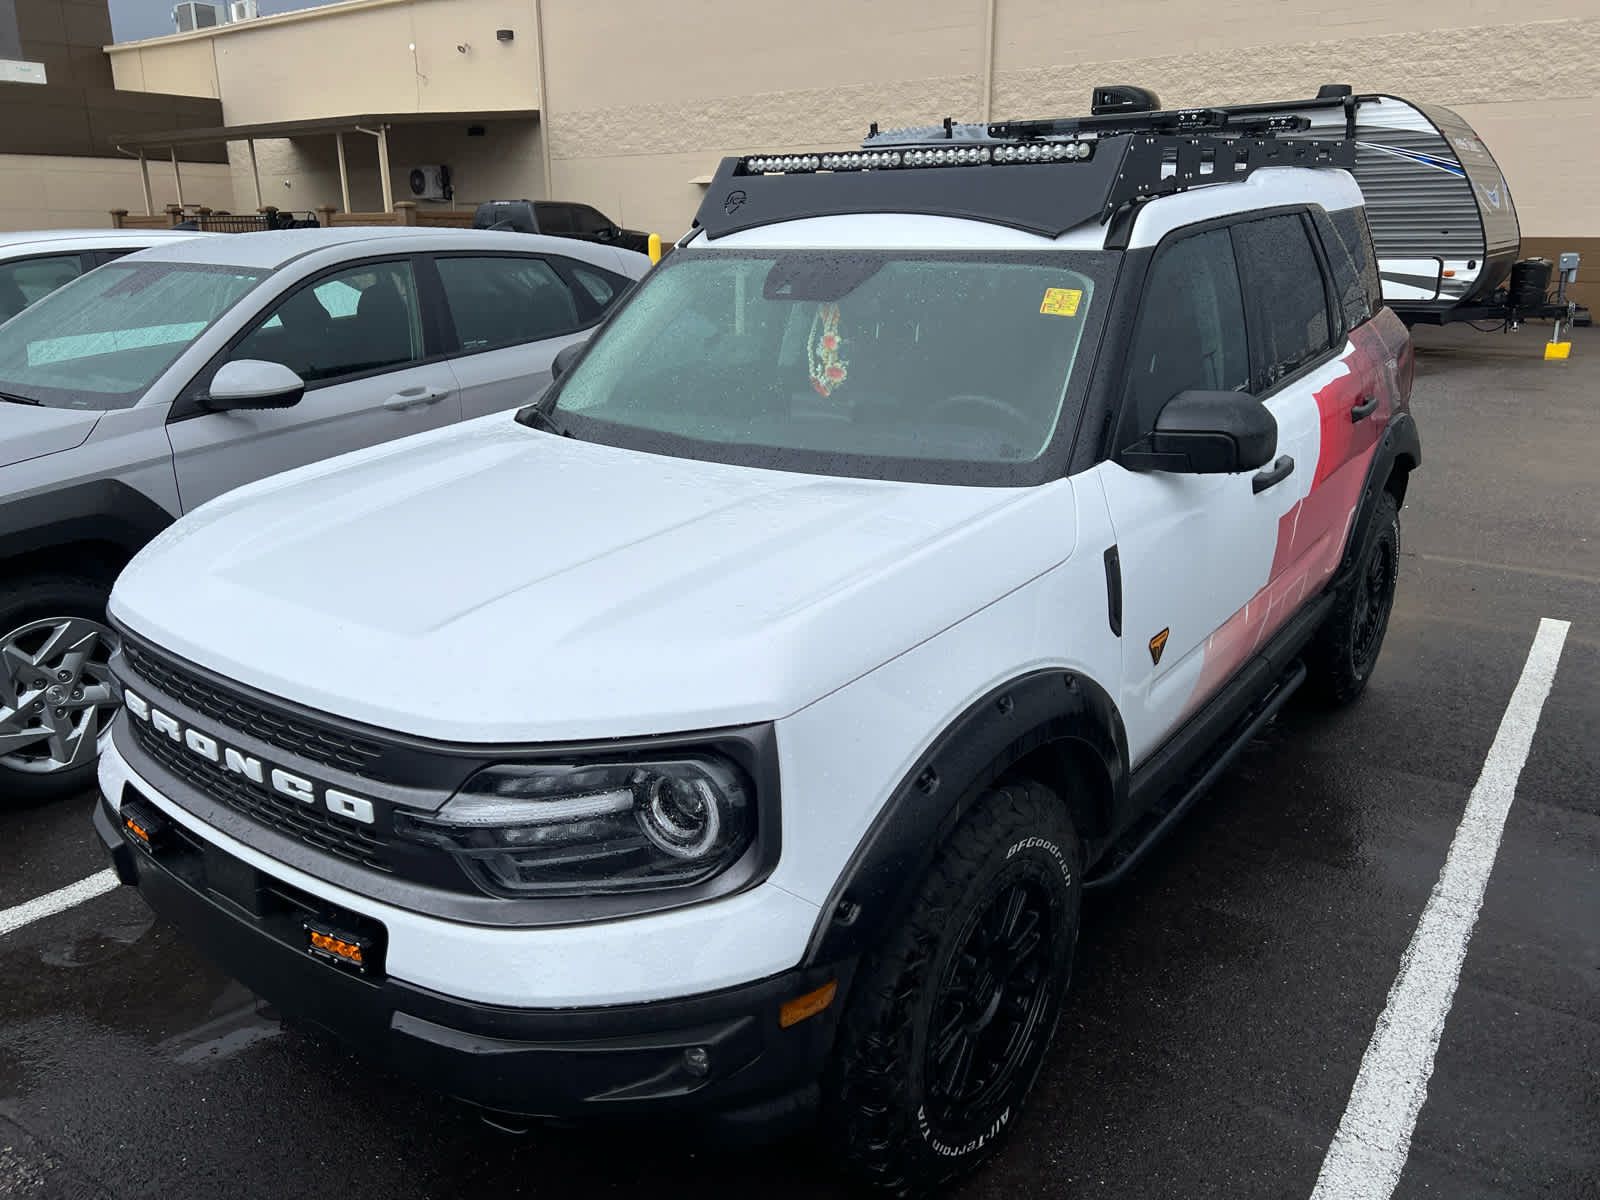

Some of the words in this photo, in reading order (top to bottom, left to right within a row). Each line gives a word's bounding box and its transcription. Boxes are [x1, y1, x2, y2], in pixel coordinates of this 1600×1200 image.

[125, 689, 375, 824] BRONCO
[1006, 836, 1072, 887] BFGoodrich
[917, 1104, 931, 1141] T/A
[932, 1105, 1010, 1157] All-Terrain
